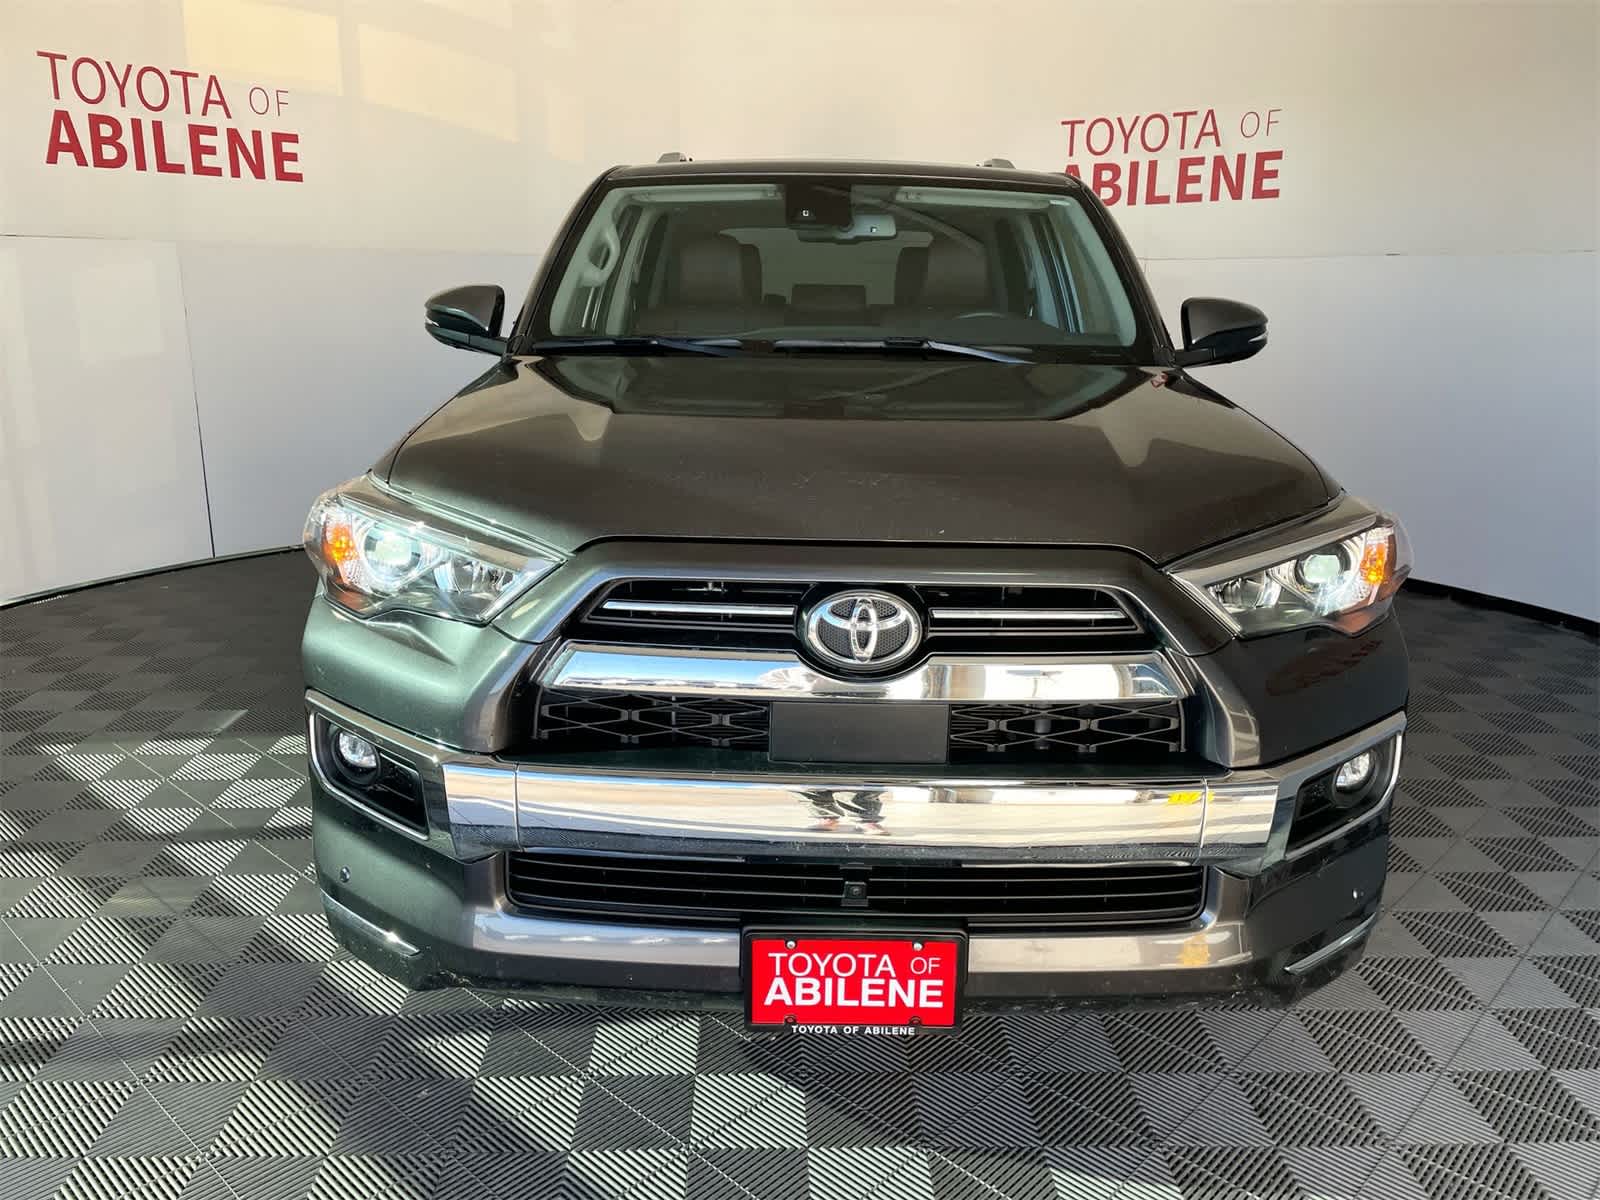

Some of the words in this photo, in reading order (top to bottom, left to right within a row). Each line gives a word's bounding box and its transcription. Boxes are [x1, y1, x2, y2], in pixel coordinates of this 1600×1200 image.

[36, 50, 232, 119] TOYOTA
[249, 86, 289, 117] OF
[46, 109, 304, 183] ABILENE
[1061, 109, 1222, 157] TOYOTA
[1240, 109, 1283, 138] OF
[768, 953, 896, 977] TOYOTA
[910, 956, 941, 975] OF
[763, 976, 944, 1008] ABILENE
[791, 1024, 838, 1034] TOYOTA
[843, 1025, 859, 1035] OF
[864, 1026, 915, 1036] ABILENE
